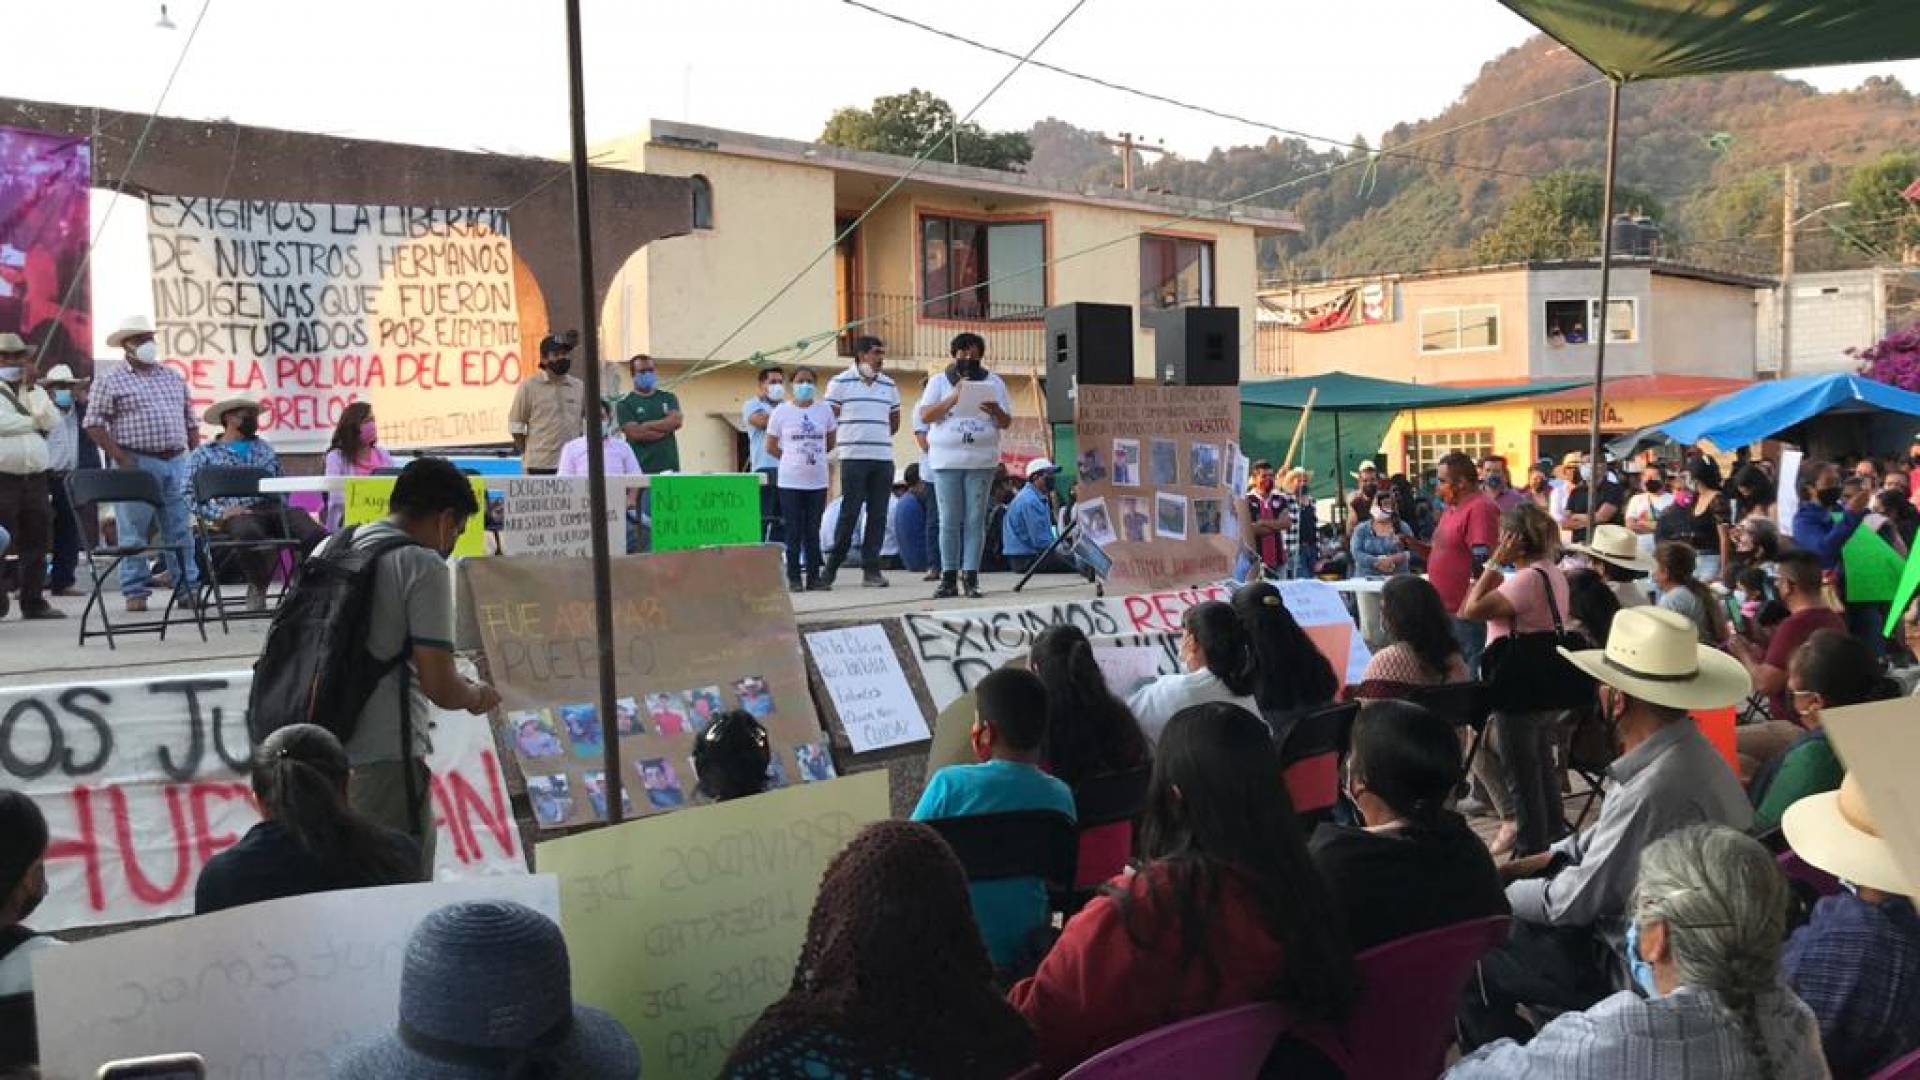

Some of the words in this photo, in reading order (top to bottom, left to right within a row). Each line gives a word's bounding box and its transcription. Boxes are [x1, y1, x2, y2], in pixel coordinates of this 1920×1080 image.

[148, 197, 317, 235] EXIGIMOS
[330, 204, 372, 234] LA
[148, 234, 199, 274] DE
[214, 238, 363, 279] NUESTROS
[378, 242, 510, 279] HERMANOS
[152, 277, 315, 318] INDIGENAS
[319, 284, 383, 317] QUE
[400, 283, 512, 316] FUERON
[155, 320, 368, 356] TORTURADOS
[379, 319, 426, 348] POR
[227, 360, 266, 389] LA
[277, 355, 386, 389] POLICIA
[395, 352, 451, 391] DEL
[461, 351, 522, 386] EDO
[257, 392, 357, 431] ORELO
